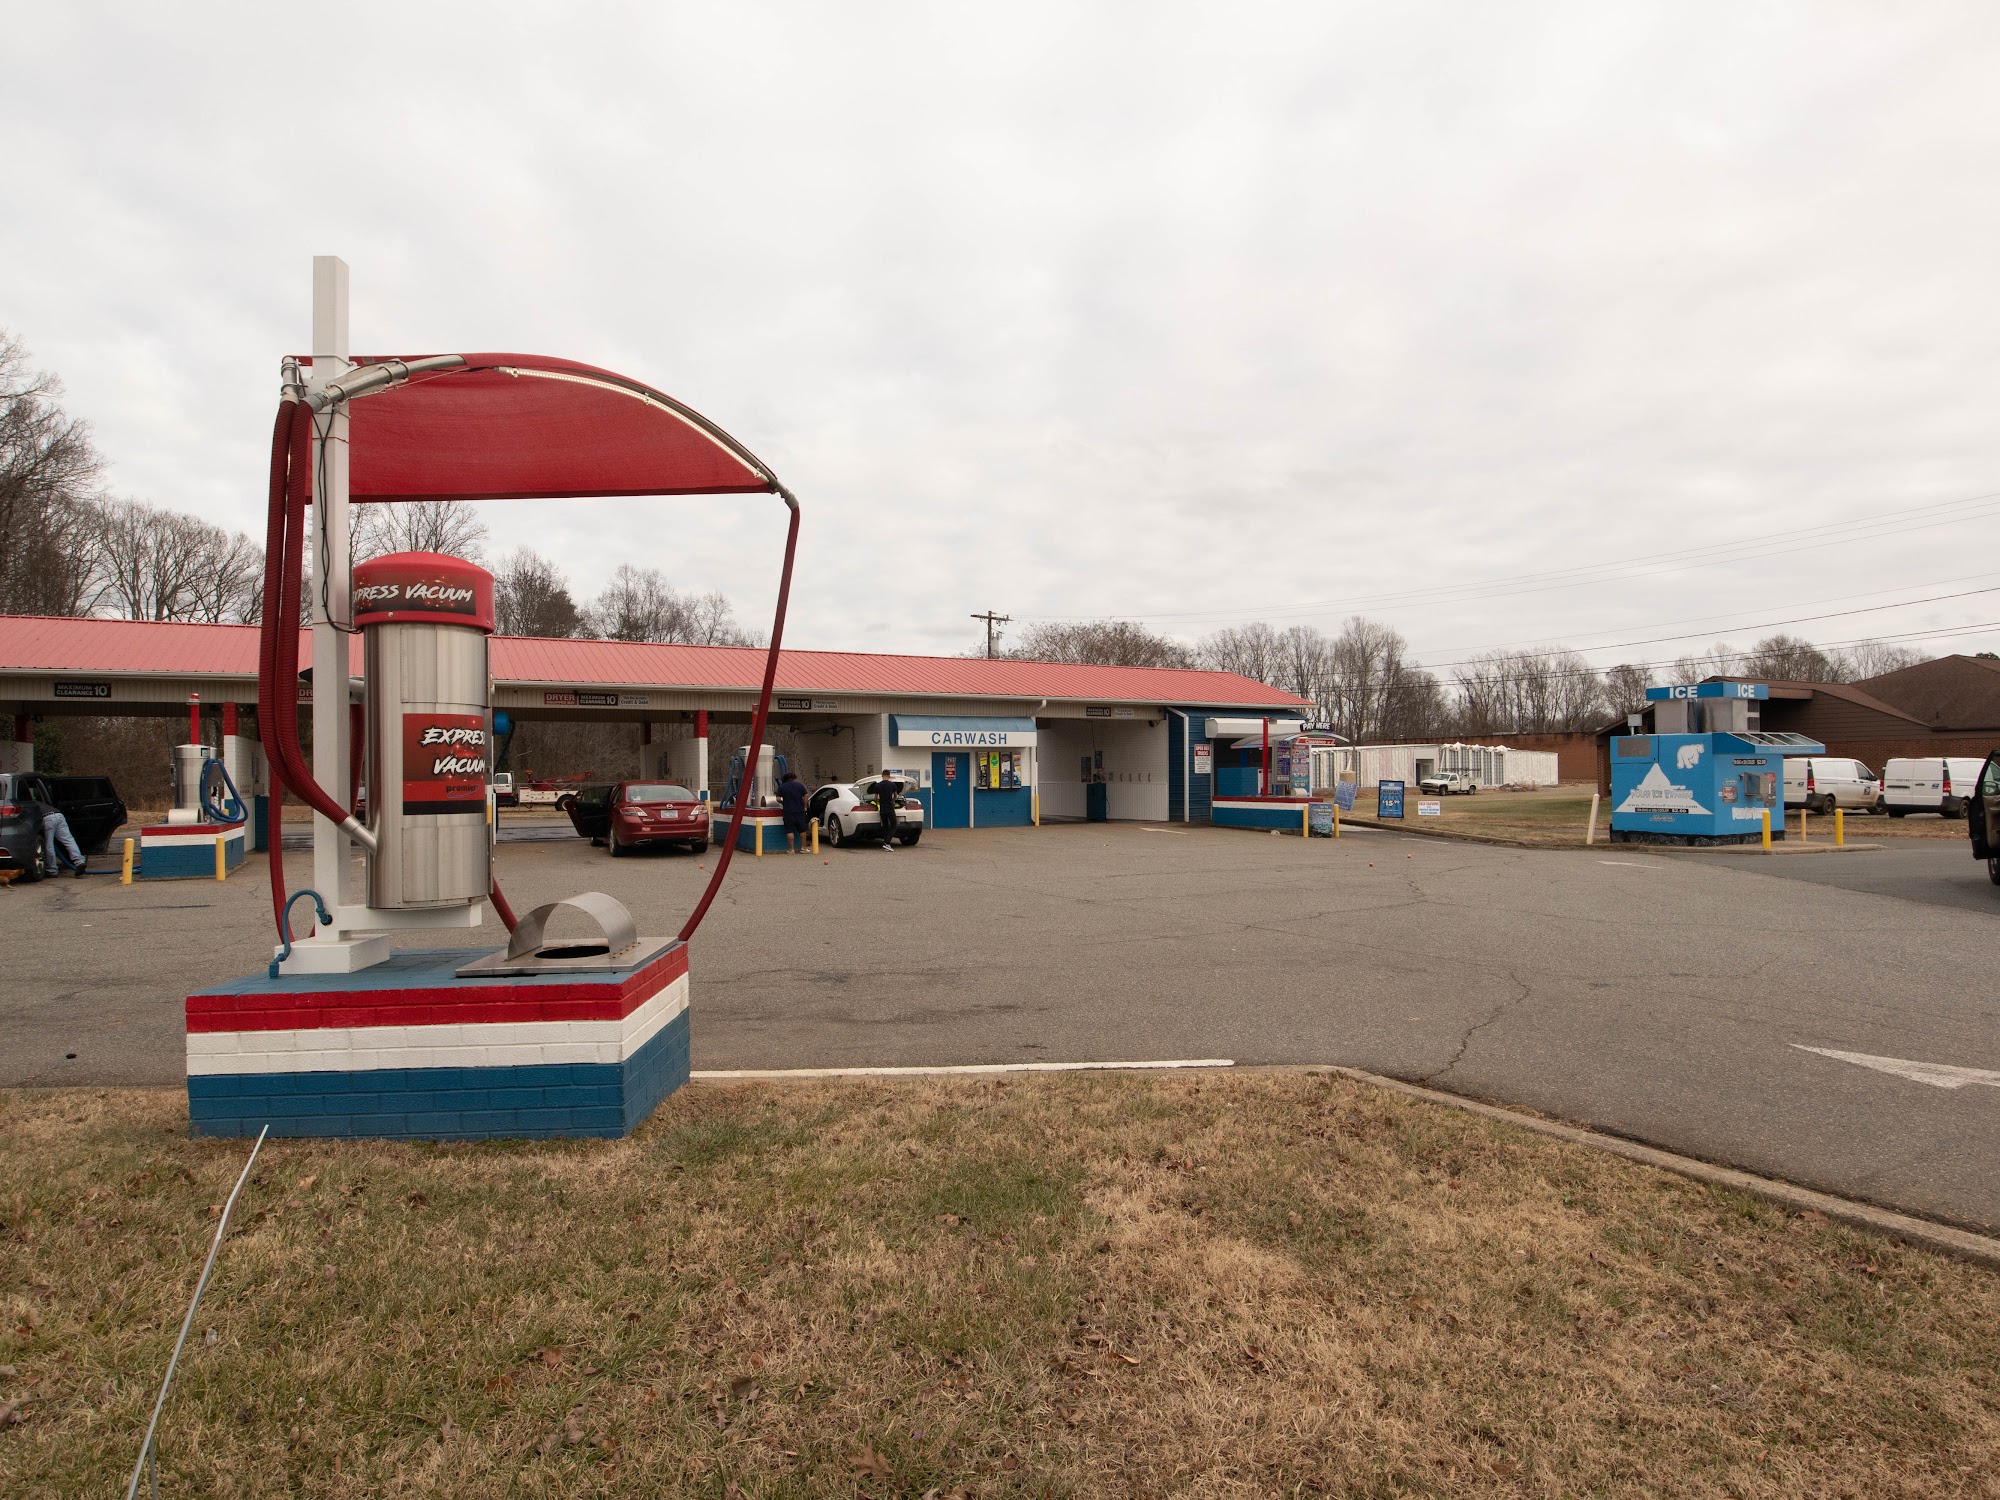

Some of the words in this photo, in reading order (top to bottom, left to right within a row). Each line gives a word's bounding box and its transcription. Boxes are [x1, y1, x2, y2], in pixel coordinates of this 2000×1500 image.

[352, 585, 400, 603] XPRESS
[405, 582, 473, 602] VACUUM
[546, 693, 575, 701] DRYER
[1669, 686, 1698, 699] ICE
[1737, 684, 1755, 698] ICE
[1302, 722, 1315, 731] PAY
[1315, 722, 1331, 730] HERE
[931, 732, 1008, 745] CARWASH
[446, 784, 477, 793] premier
